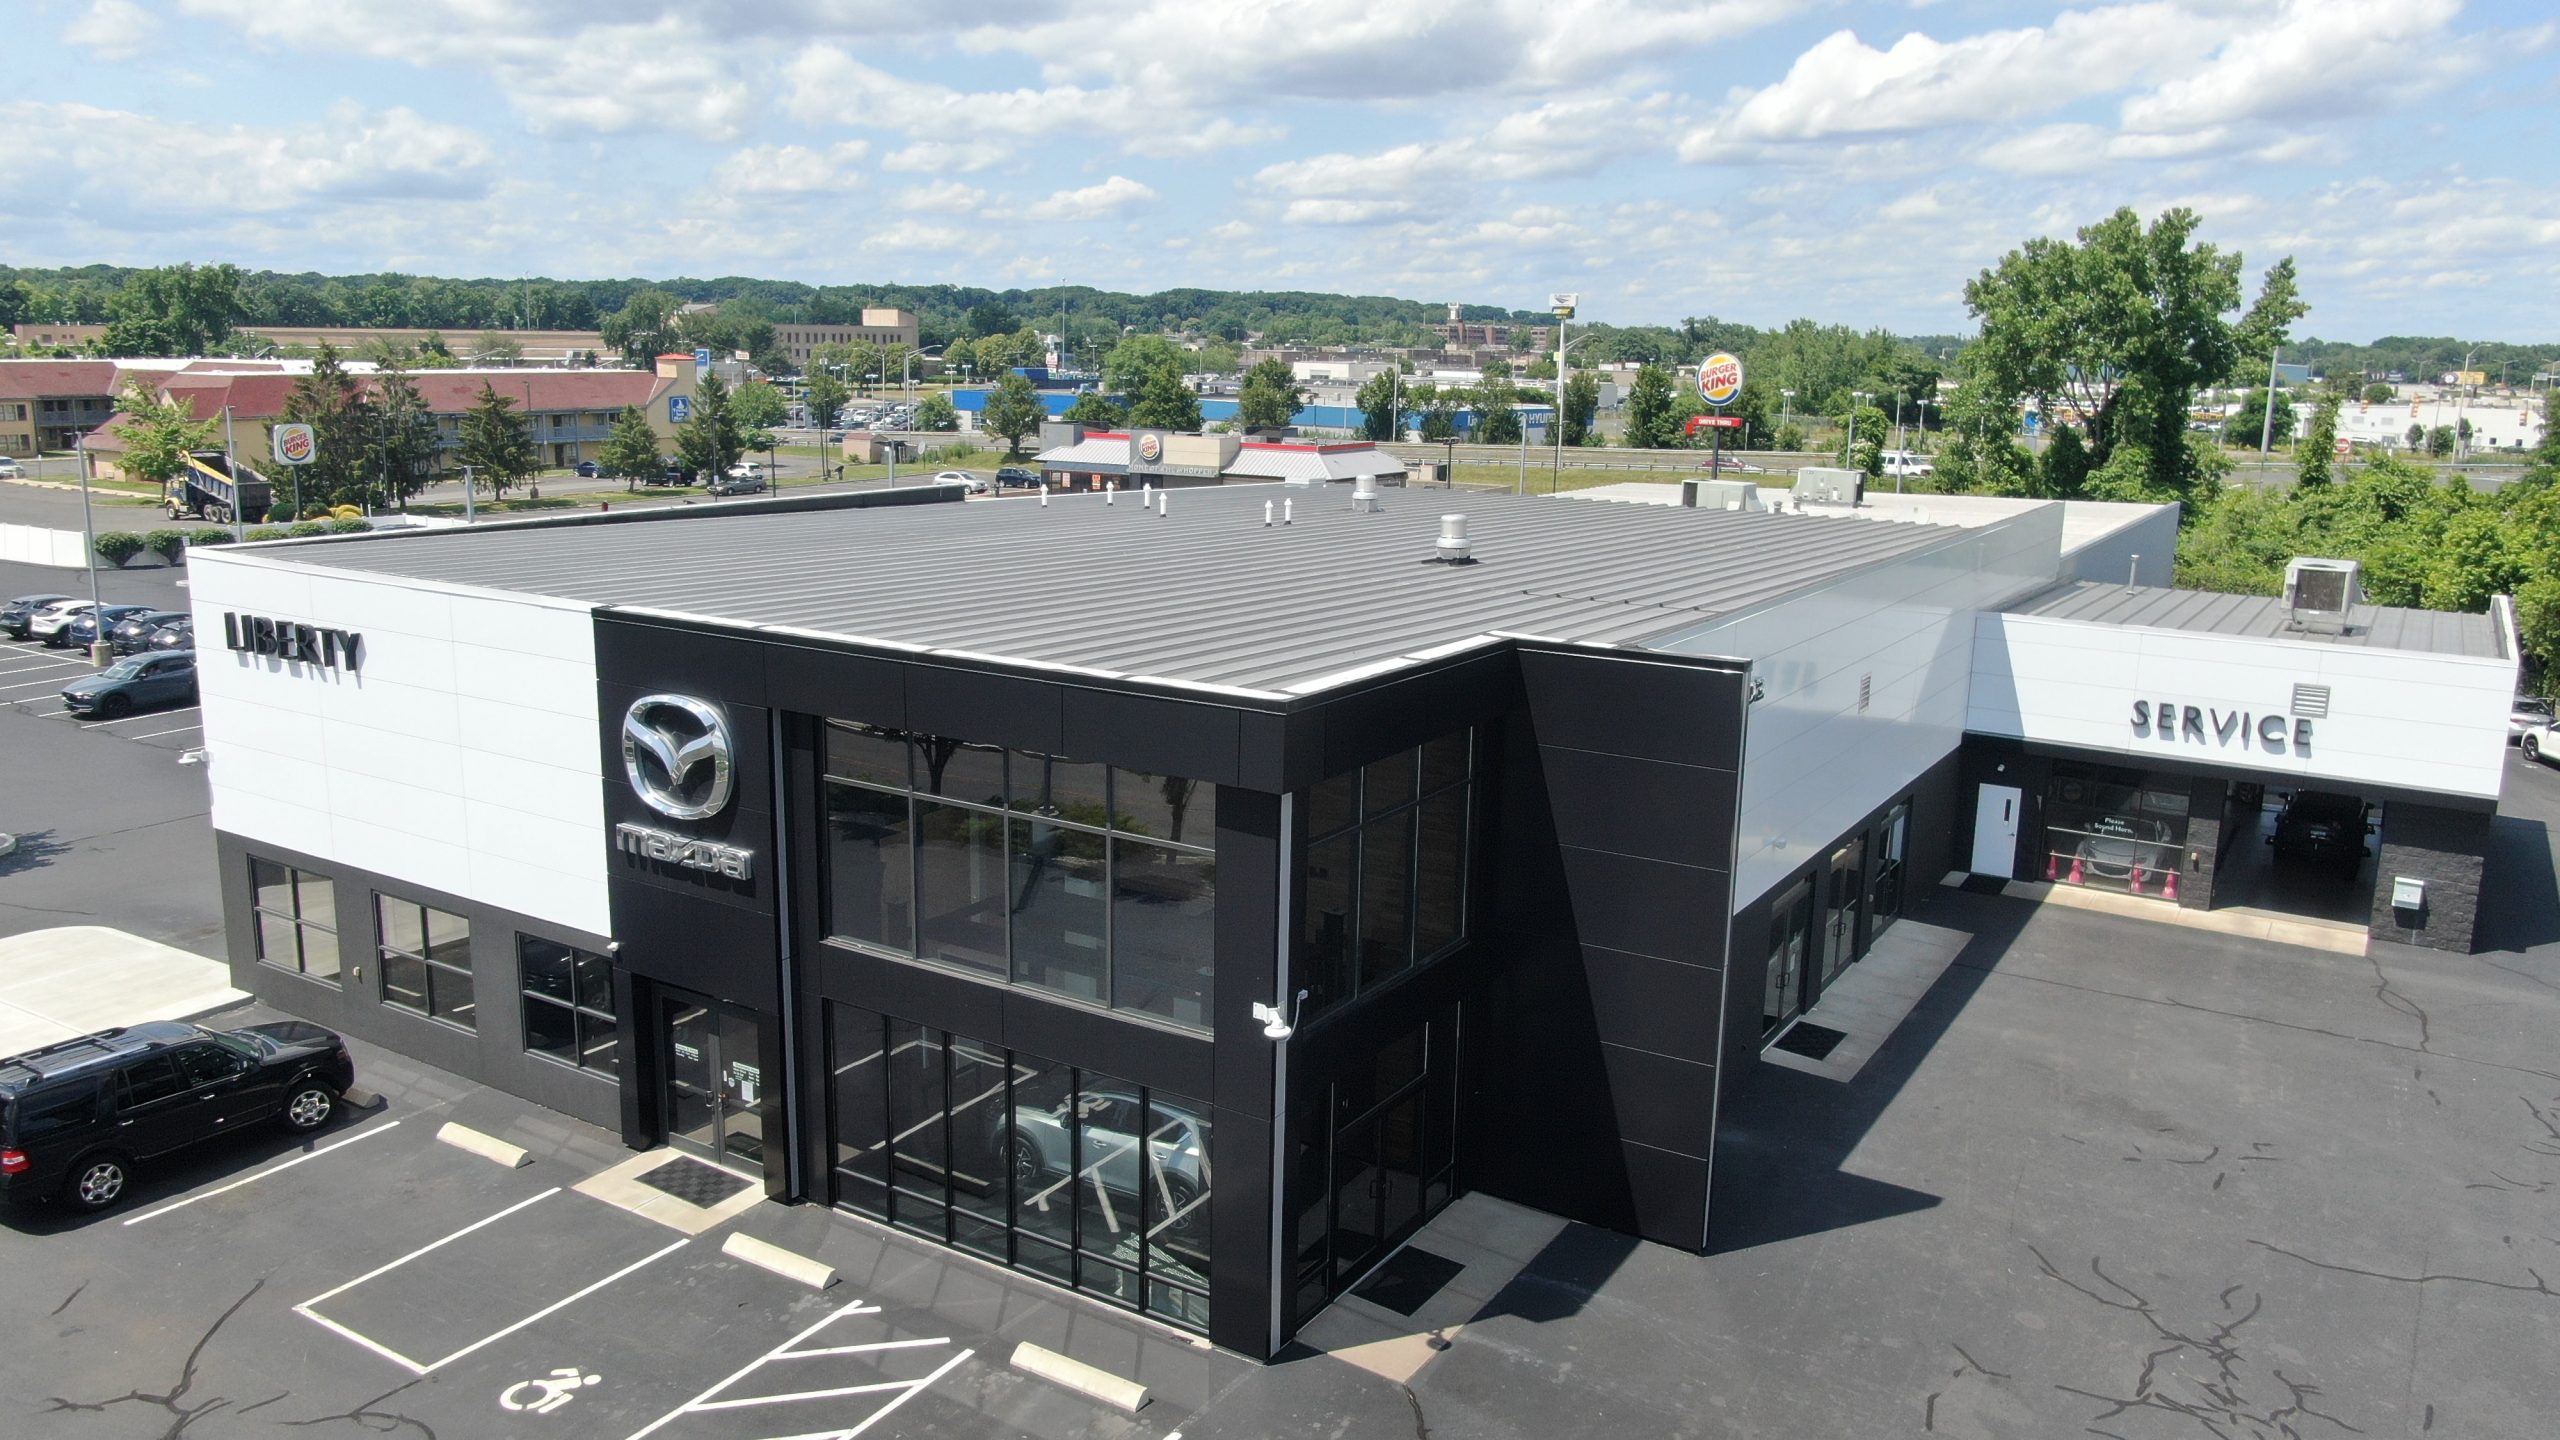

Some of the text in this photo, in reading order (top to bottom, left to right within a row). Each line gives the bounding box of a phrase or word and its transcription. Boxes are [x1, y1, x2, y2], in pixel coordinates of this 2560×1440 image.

[1701, 363, 1737, 381] BURGER
[1701, 372, 1738, 393] KING
[283, 432, 307, 447] BURGER
[285, 439, 309, 455] KING
[1142, 444, 1157, 452] KING
[224, 612, 361, 671] LIBERTY
[2130, 700, 2313, 746] SERVICE
[2105, 817, 2125, 825] Please
[616, 823, 752, 880] mazda
